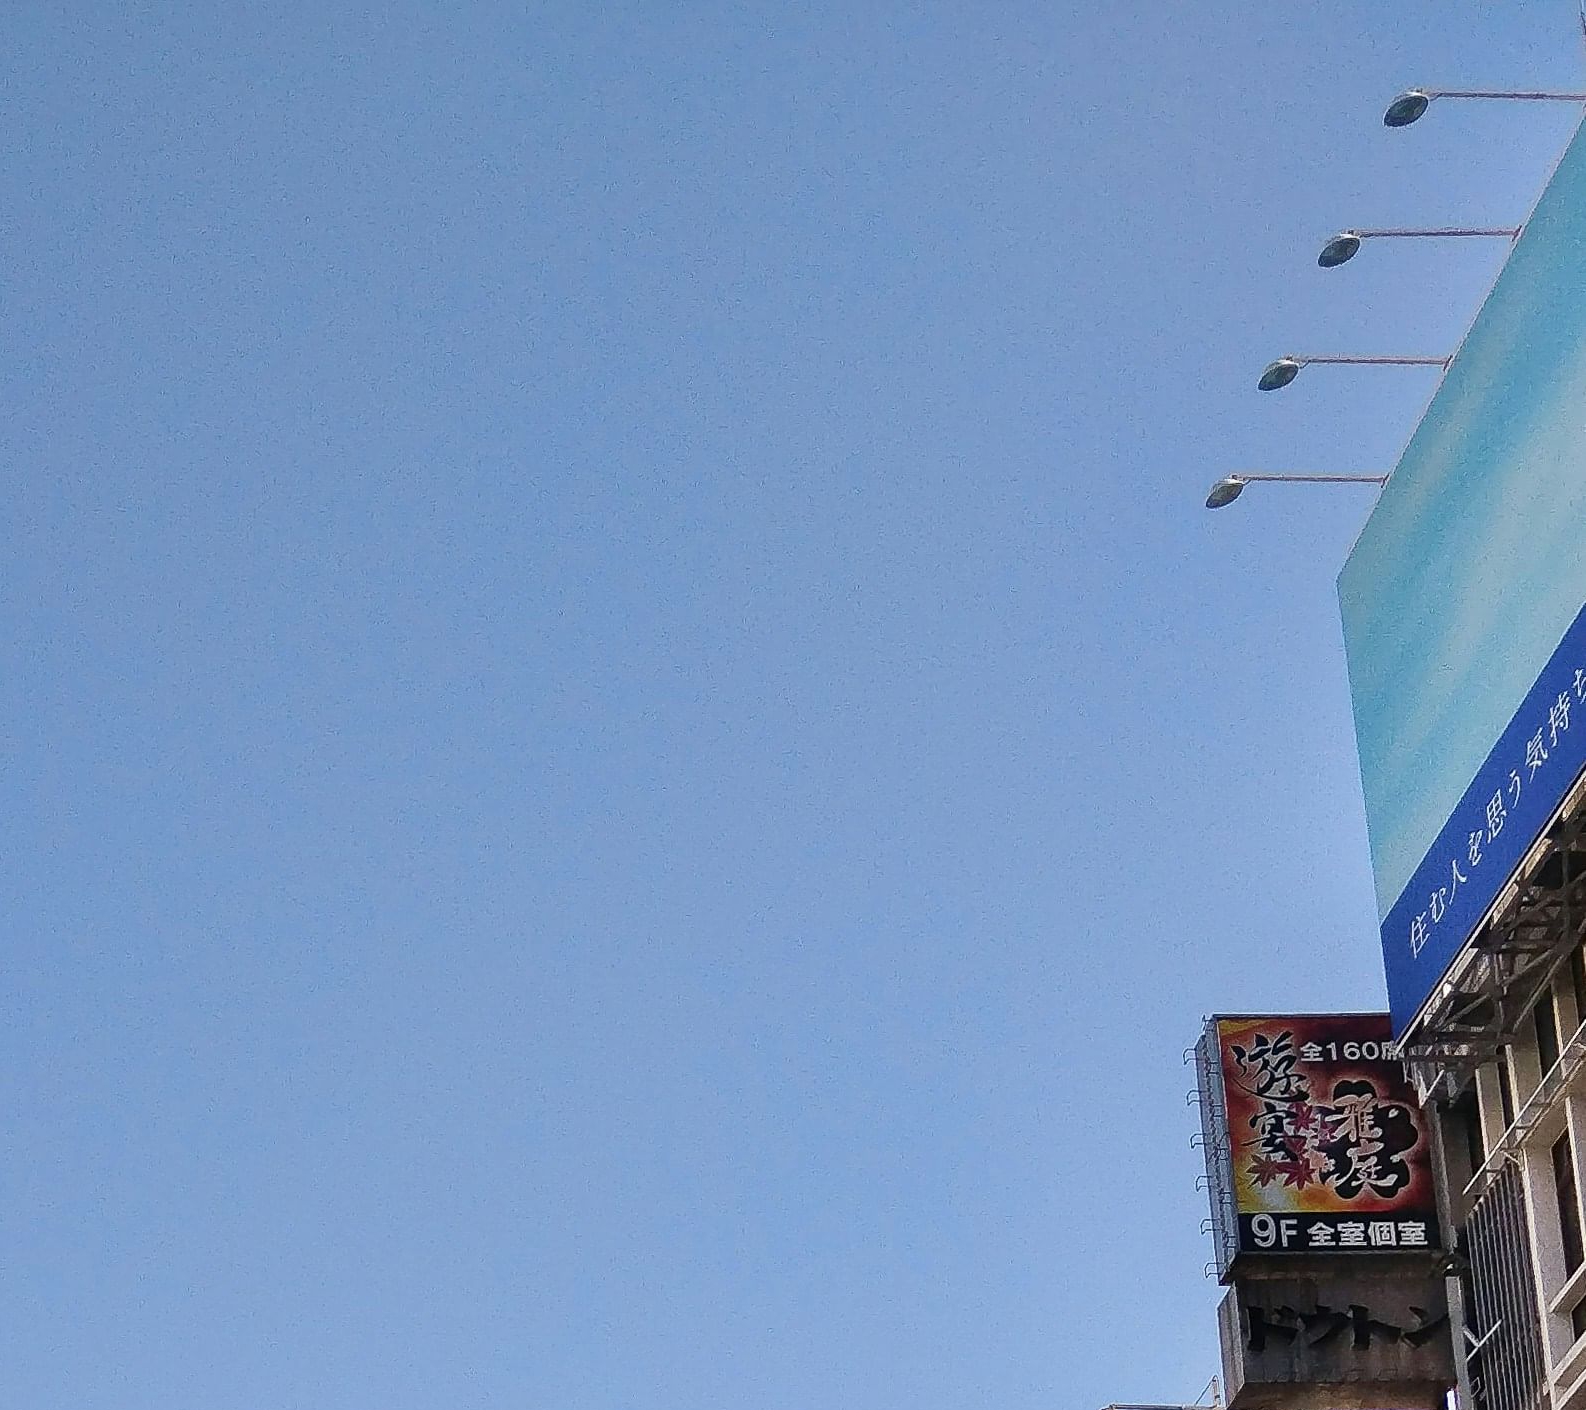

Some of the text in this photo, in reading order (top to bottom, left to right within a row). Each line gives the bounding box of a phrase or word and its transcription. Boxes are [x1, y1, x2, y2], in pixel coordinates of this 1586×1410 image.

[1251, 1215, 1429, 1249] 9F 全室個室
